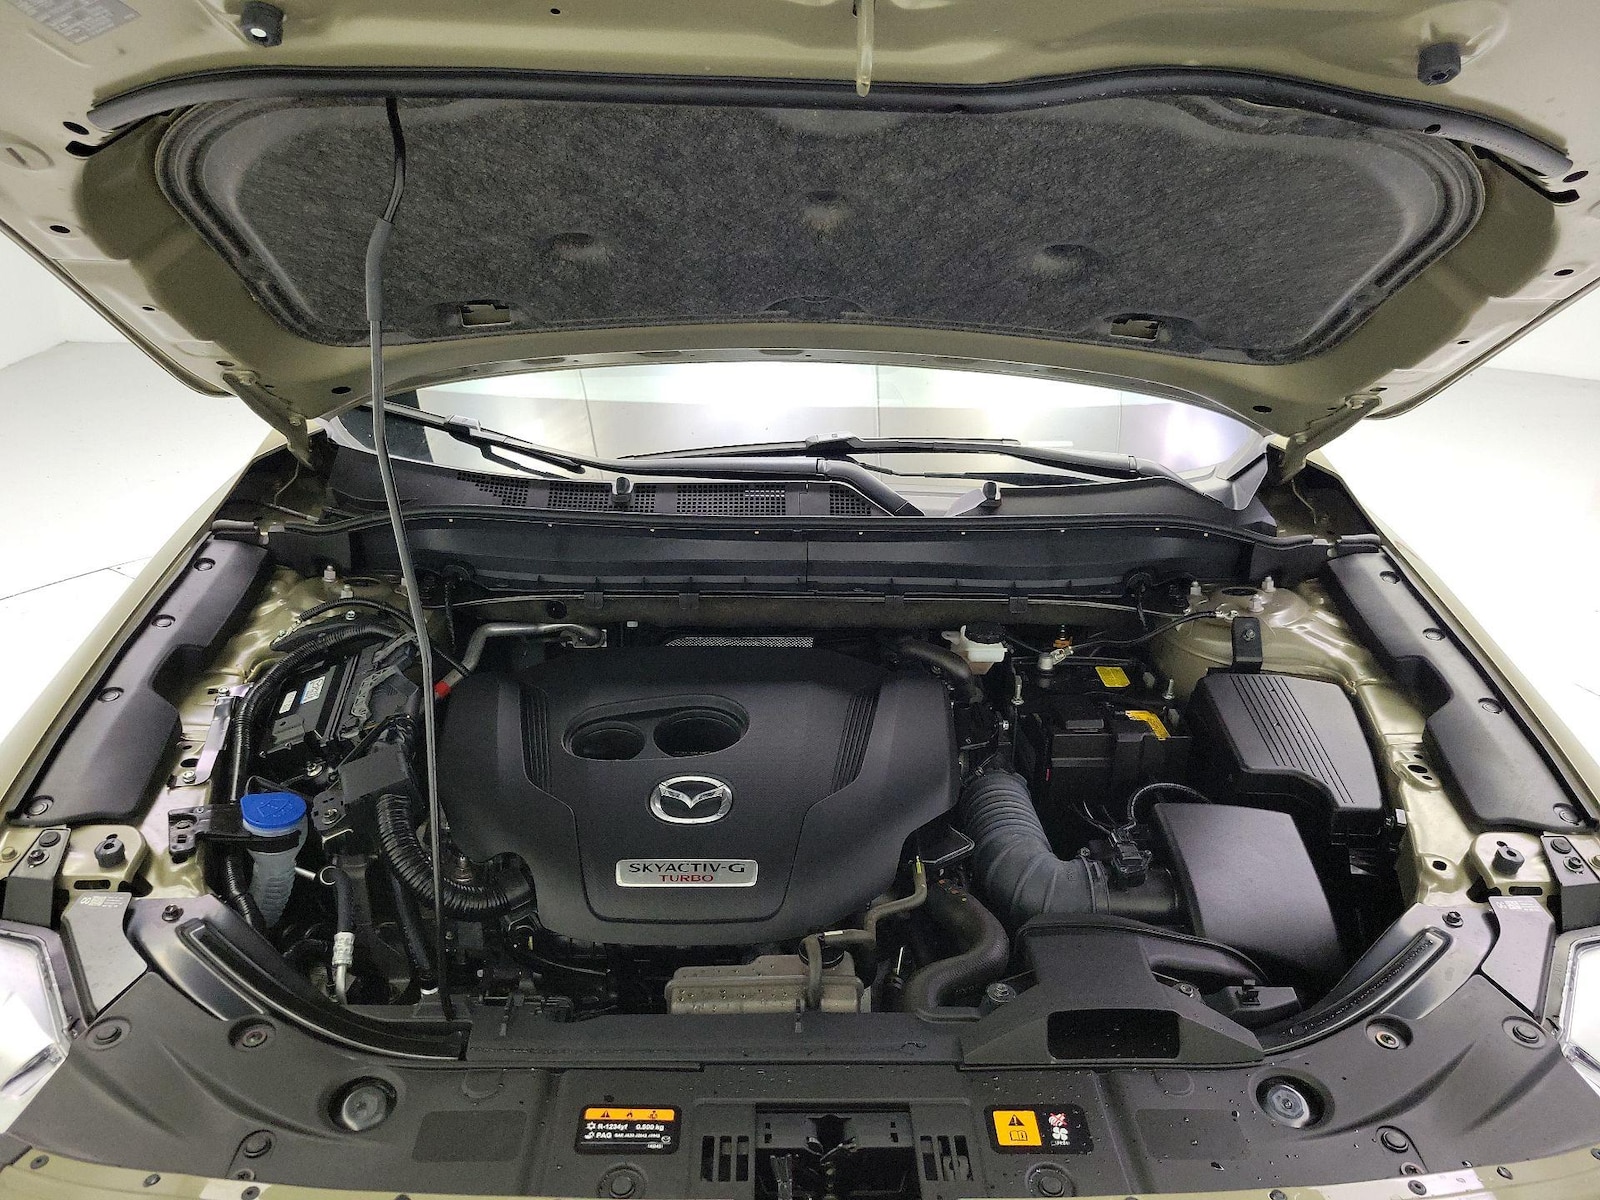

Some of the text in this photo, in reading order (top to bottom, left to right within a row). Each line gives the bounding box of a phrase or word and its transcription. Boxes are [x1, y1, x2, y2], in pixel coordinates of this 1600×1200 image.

[628, 863, 745, 873] SKYACTIV-G
[659, 874, 714, 882] TURBO
[597, 1123, 628, 1131] R-1234yf
[655, 1123, 665, 1132] kg
